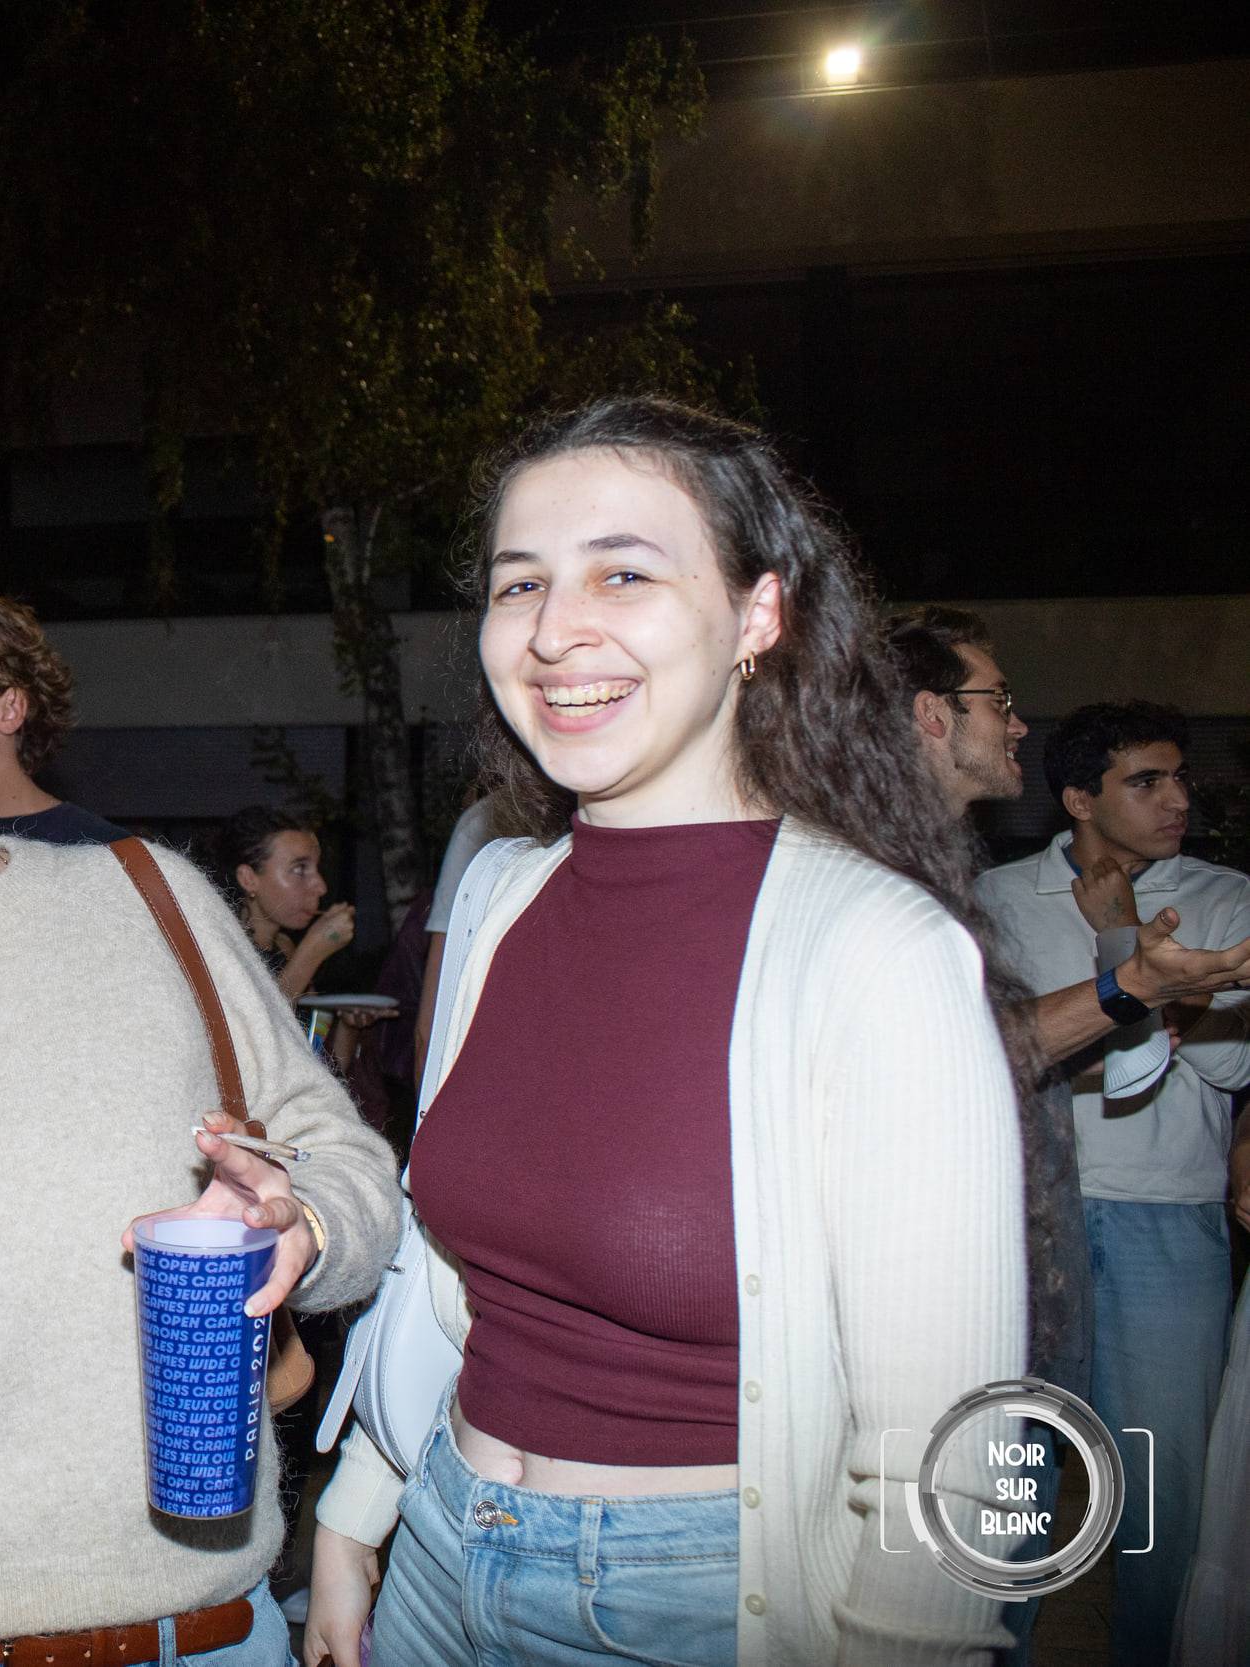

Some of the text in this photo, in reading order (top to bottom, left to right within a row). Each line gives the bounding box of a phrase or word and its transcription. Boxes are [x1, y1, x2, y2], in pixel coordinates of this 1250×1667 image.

[158, 1258, 200, 1272] OPEN
[205, 1260, 245, 1273] GAM
[152, 1284, 172, 1298] LES
[175, 1289, 213, 1301] JEUX
[188, 1303, 229, 1315] WIDE
[161, 1314, 199, 1328] OPEN
[205, 1316, 242, 1328] GAM
[154, 1340, 174, 1353] LES
[176, 1344, 211, 1356] JEUX
[251, 1316, 265, 1370] 202
[189, 1358, 226, 1370] WIDE
[162, 1368, 199, 1383] OPEN
[204, 1371, 239, 1383] GAM
[157, 1395, 175, 1408] LES
[178, 1399, 210, 1410] JEUX
[190, 1413, 224, 1424] WIDE
[165, 1423, 200, 1437] OPEN
[204, 1424, 236, 1438] GAM
[159, 1449, 177, 1462] LES
[180, 1453, 209, 1464] JEUX
[190, 1466, 223, 1477] WIDE
[168, 1477, 199, 1491] OPEN
[162, 1503, 178, 1514] LES
[181, 1505, 211, 1516] JEUX
